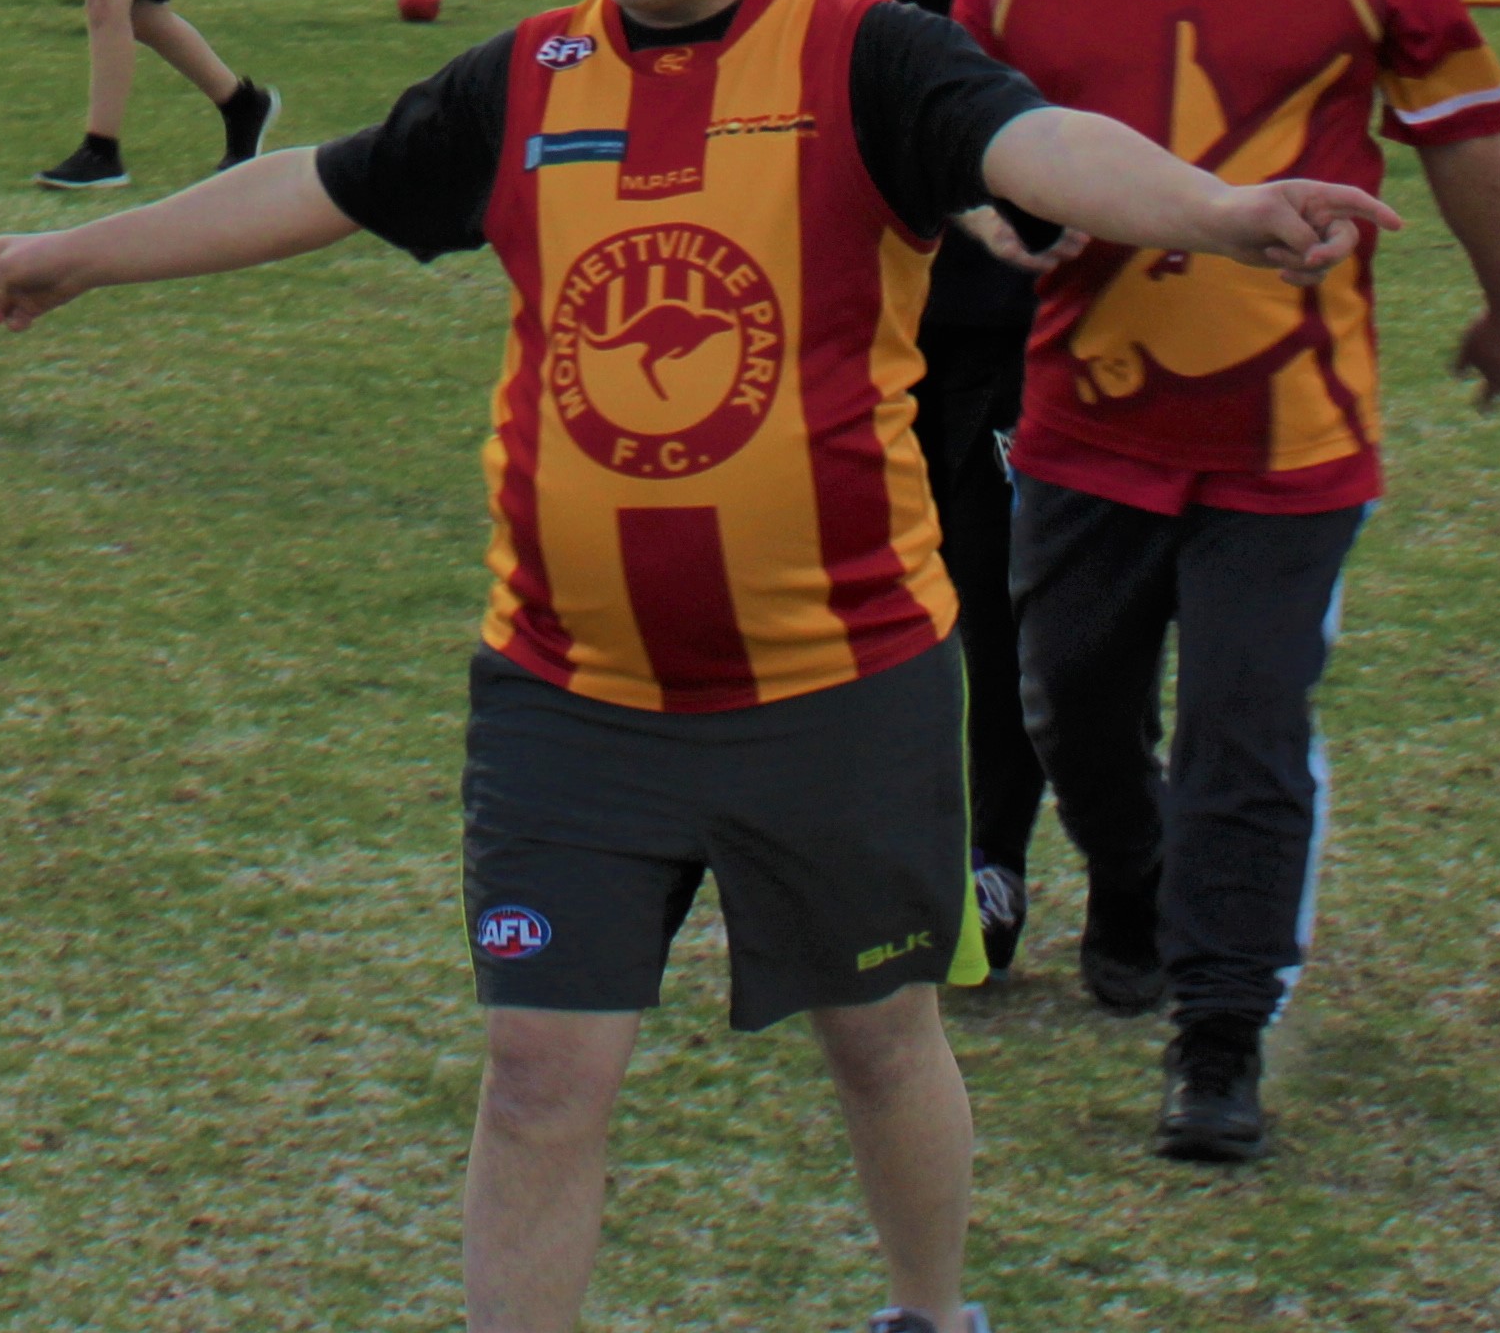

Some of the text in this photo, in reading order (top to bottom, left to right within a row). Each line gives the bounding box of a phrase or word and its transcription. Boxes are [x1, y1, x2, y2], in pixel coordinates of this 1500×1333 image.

[553, 231, 777, 420] MORPHETTVILLE PARK
[482, 919, 541, 947] AFL
[857, 932, 932, 971] BLK
